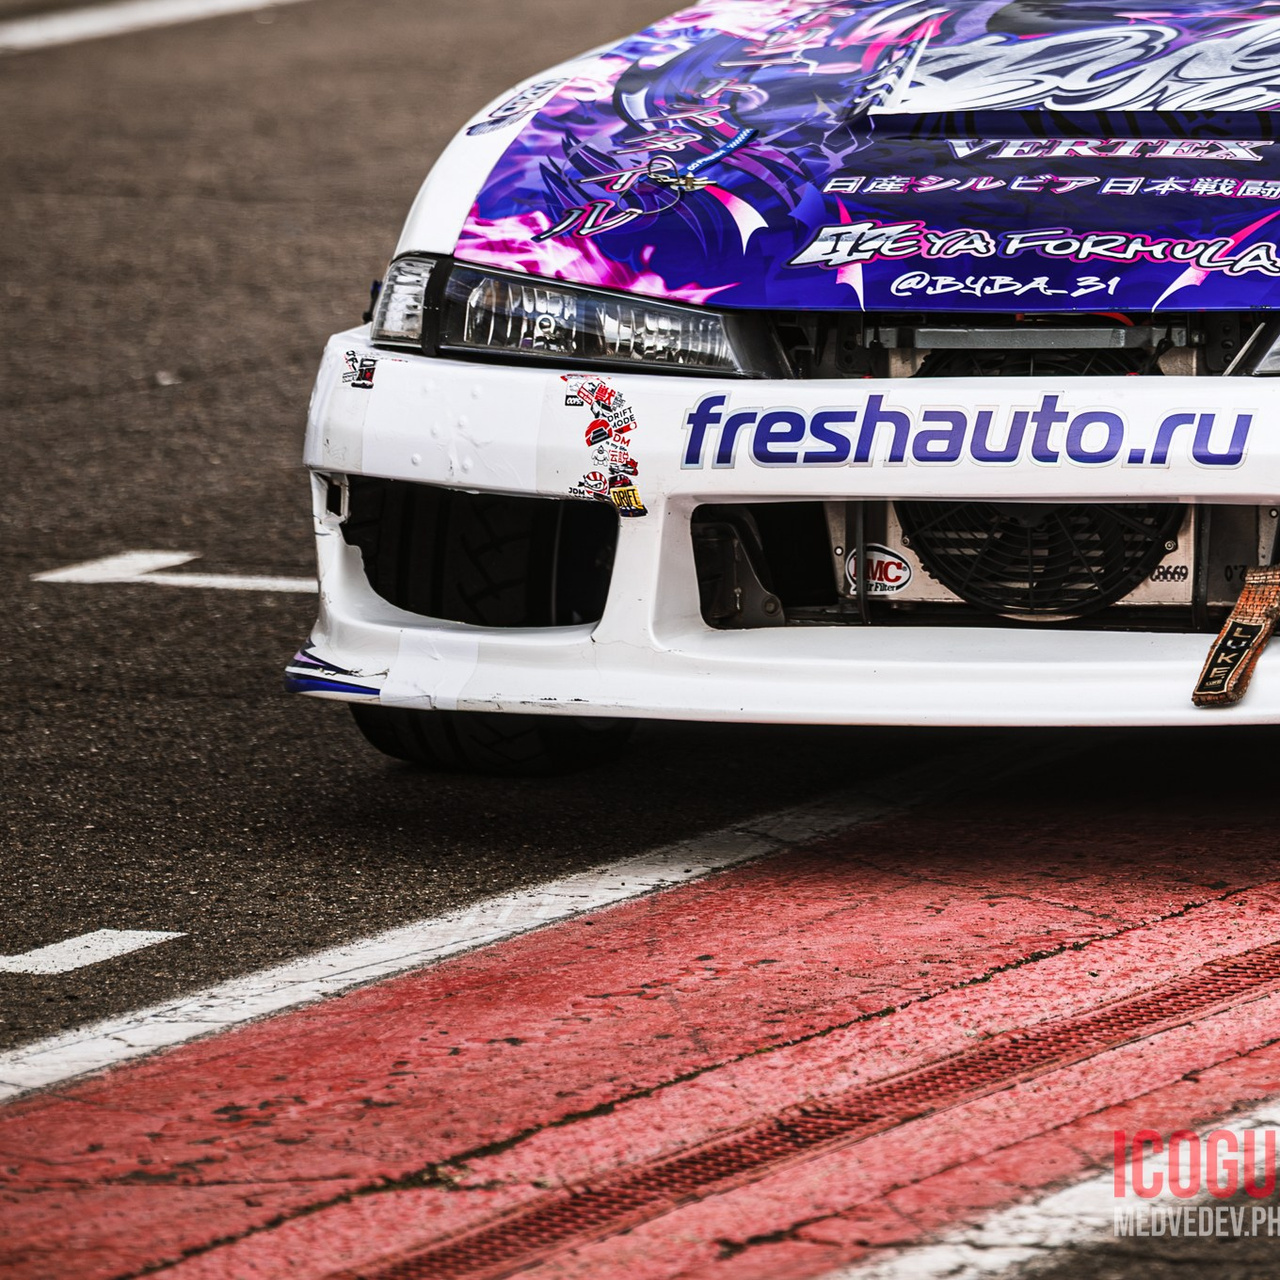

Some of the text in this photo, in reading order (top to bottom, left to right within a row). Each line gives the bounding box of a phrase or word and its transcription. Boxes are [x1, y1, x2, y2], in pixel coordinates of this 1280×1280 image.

[944, 139, 1274, 162] VERTEX
[607, 406, 633, 422] DRIFT
[685, 394, 1254, 466] freshauto.ru
[568, 487, 585, 496] JDM
[612, 488, 639, 507] DRIFT
[1208, 627, 1252, 679] LUKE
